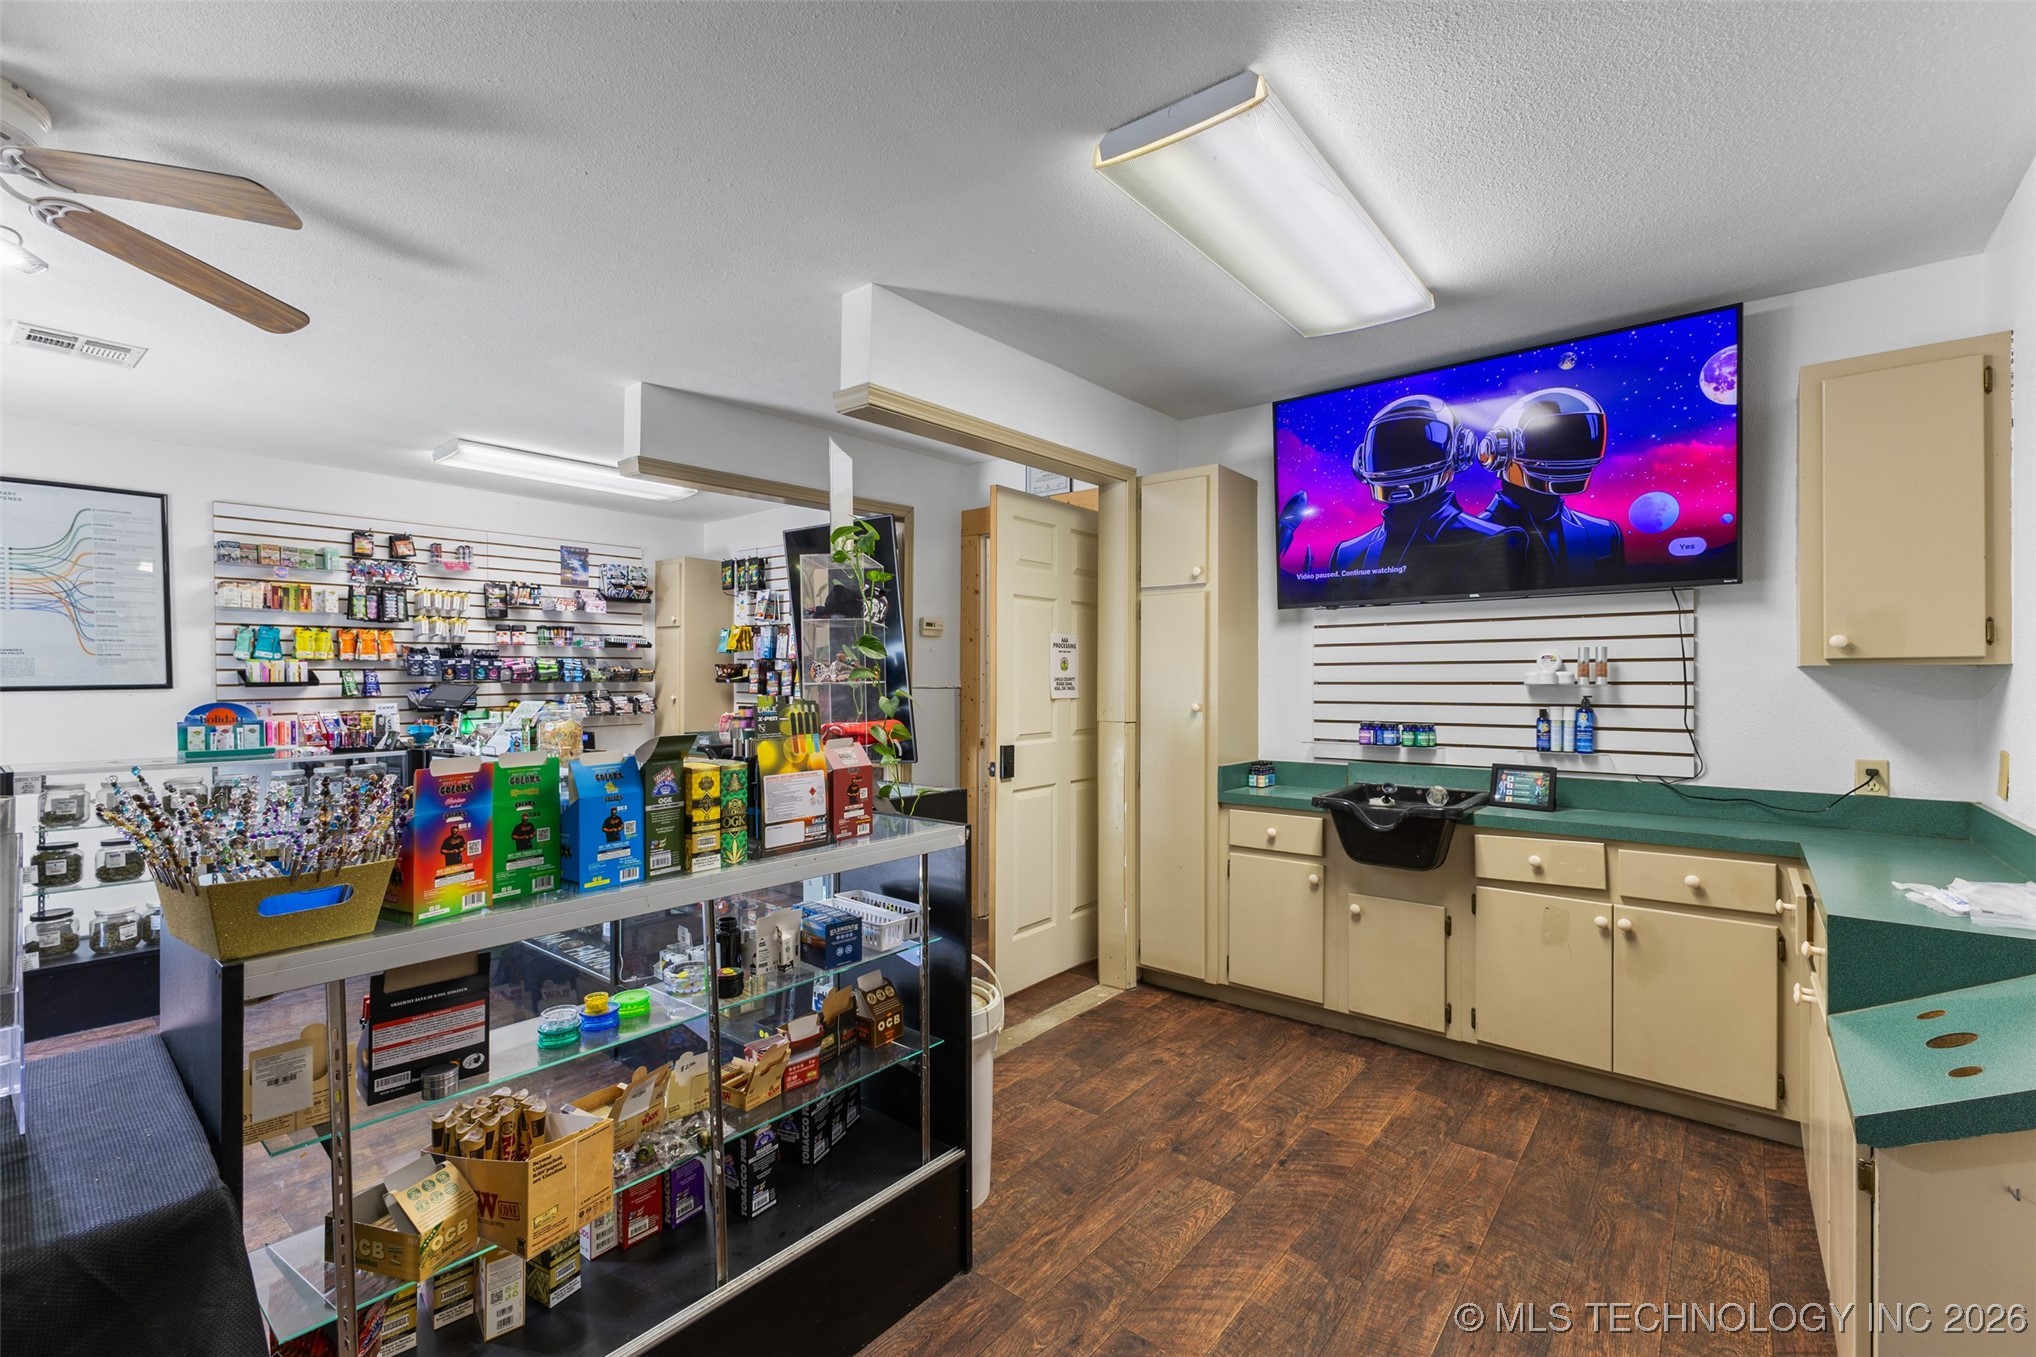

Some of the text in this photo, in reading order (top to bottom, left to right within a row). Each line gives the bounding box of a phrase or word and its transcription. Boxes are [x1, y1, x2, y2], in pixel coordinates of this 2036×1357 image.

[1679, 542, 1696, 551] Yes
[1315, 571, 1340, 580] paused.
[1341, 568, 1370, 577] Continue
[1371, 565, 1407, 576] watching?
[1052, 642, 1077, 650] PROCESSING
[757, 705, 777, 713] EAGLE
[200, 714, 244, 727] holiday
[722, 813, 747, 828] OGK
[829, 923, 859, 937] ELEMENTS
[877, 1013, 901, 1032] OCB
[641, 1109, 660, 1127] RAW
[801, 1116, 810, 1164] TOBACCO
[532, 1154, 552, 1167] Beyond
[740, 1137, 748, 1216] TOBACCO FREE
[664, 1171, 673, 1224] TOBACCO
[499, 1203, 519, 1219] CONE
[431, 1217, 469, 1251] OCB
[353, 1238, 385, 1260] CB
